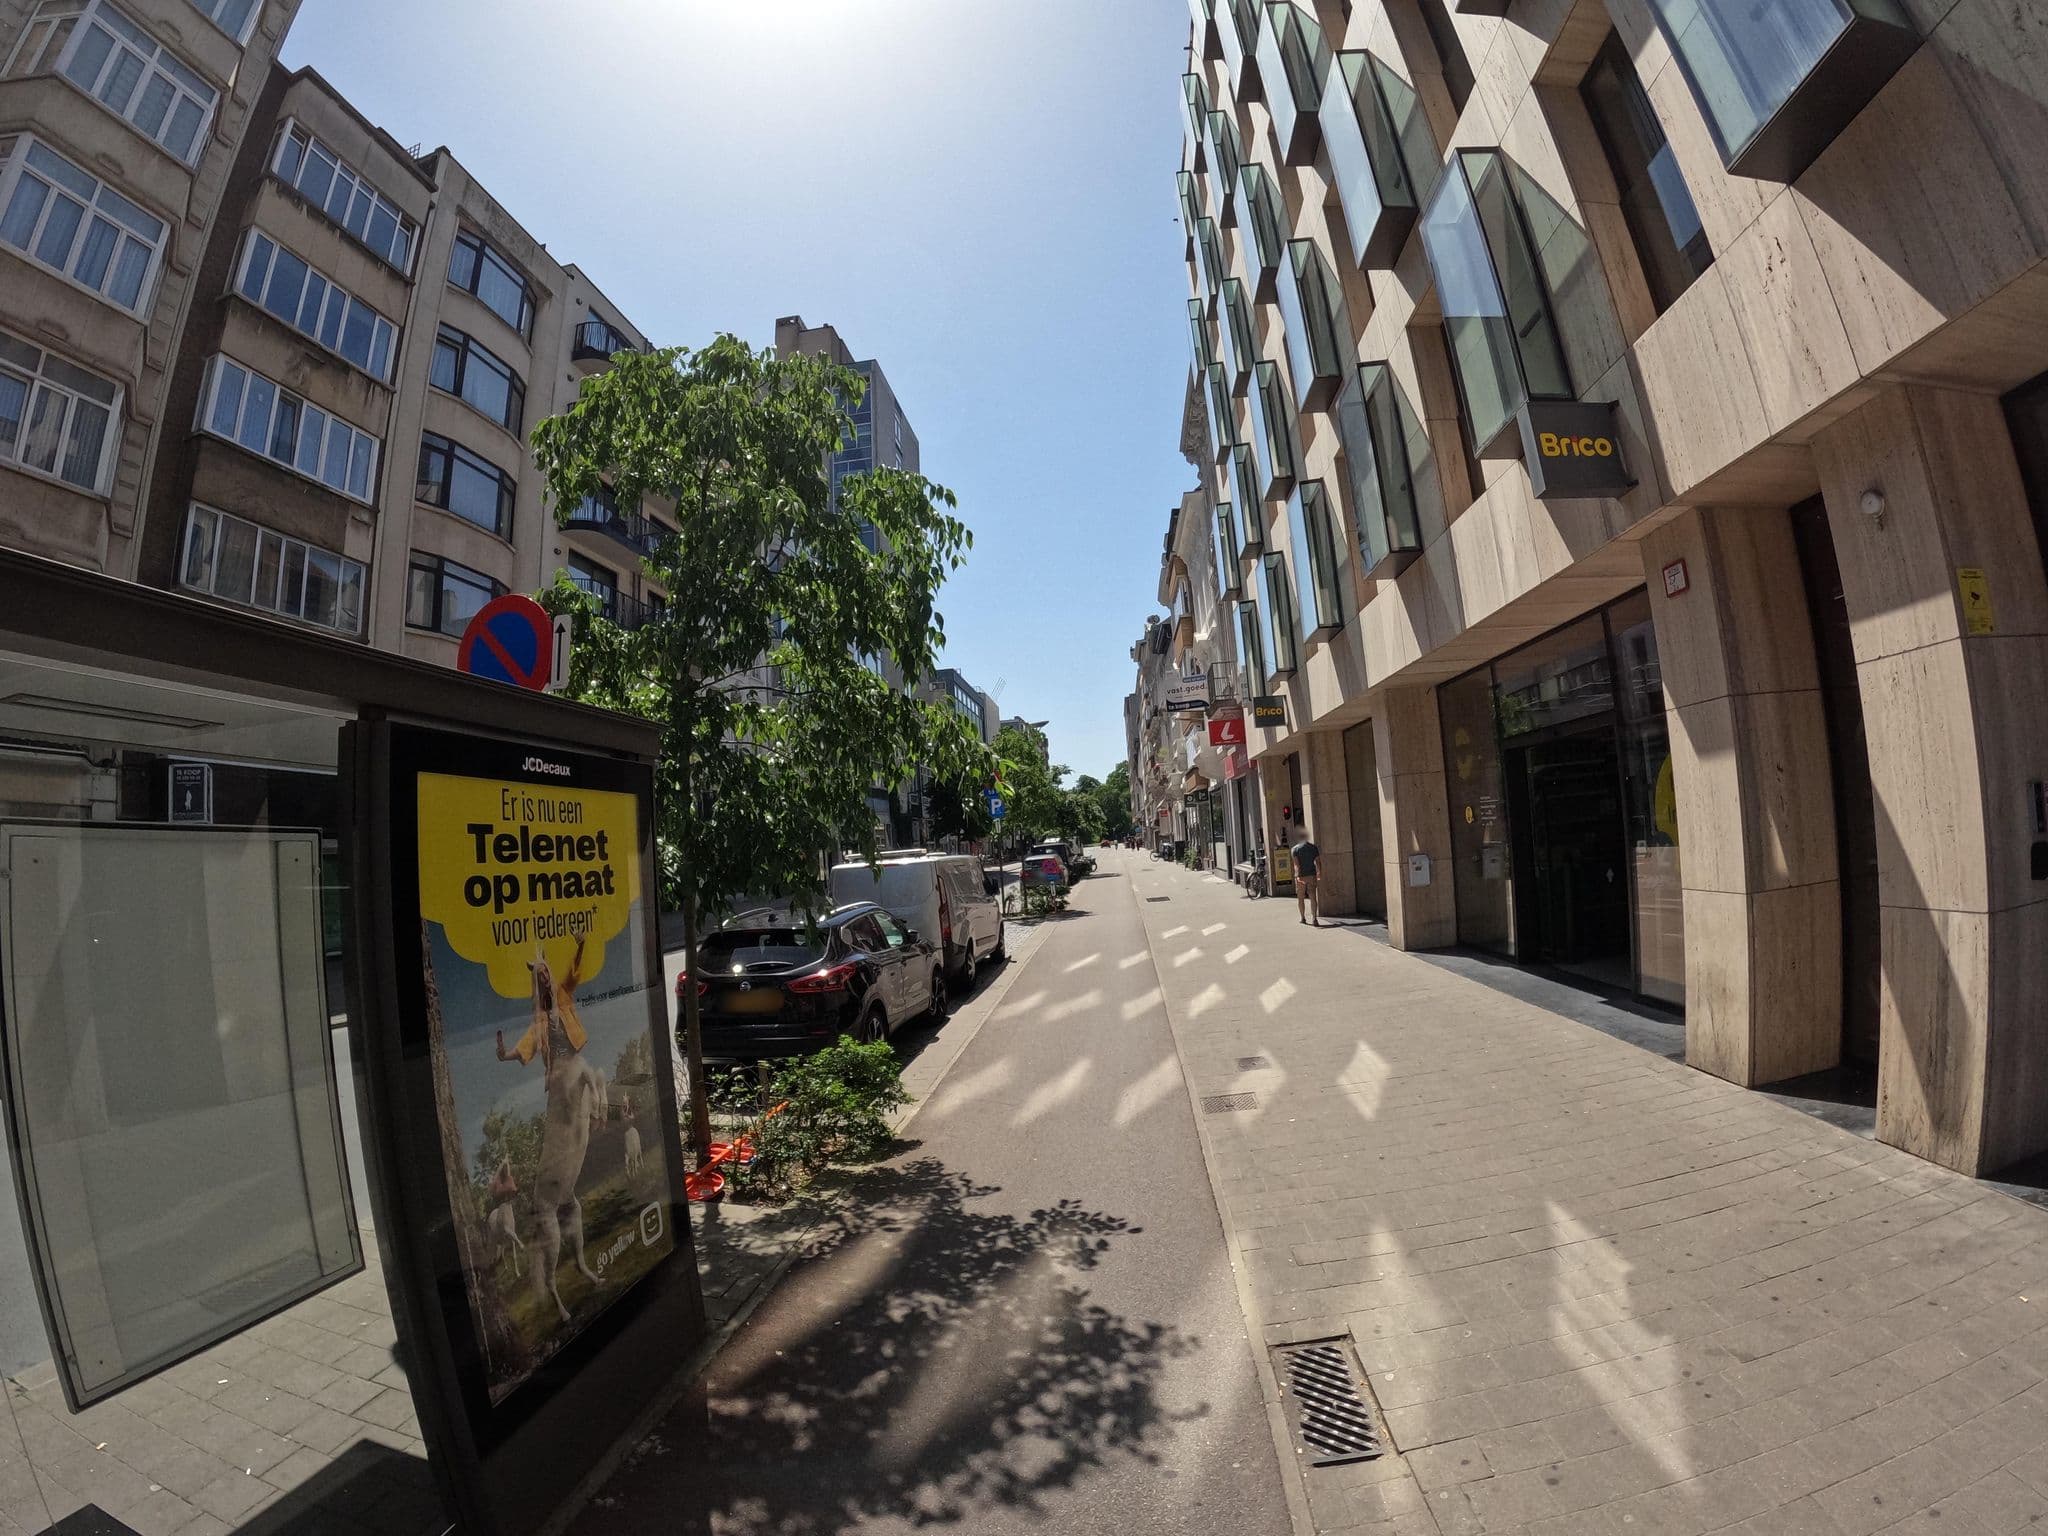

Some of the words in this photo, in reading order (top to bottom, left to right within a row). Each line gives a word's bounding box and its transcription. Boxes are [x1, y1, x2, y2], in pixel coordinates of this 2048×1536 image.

[1539, 432, 1612, 457] Brico
[1256, 707, 1283, 716] Brico
[522, 756, 571, 776] JCDecaux
[501, 788, 518, 821] Er
[522, 791, 535, 822] is
[538, 801, 556, 823] nu
[558, 802, 582, 824] een
[991, 799, 1002, 815] P
[467, 823, 608, 864] Telenet
[464, 873, 520, 914] op
[528, 864, 615, 902] maat
[492, 917, 529, 947] voor
[597, 1252, 608, 1274] go
[608, 1230, 635, 1264] yellow
